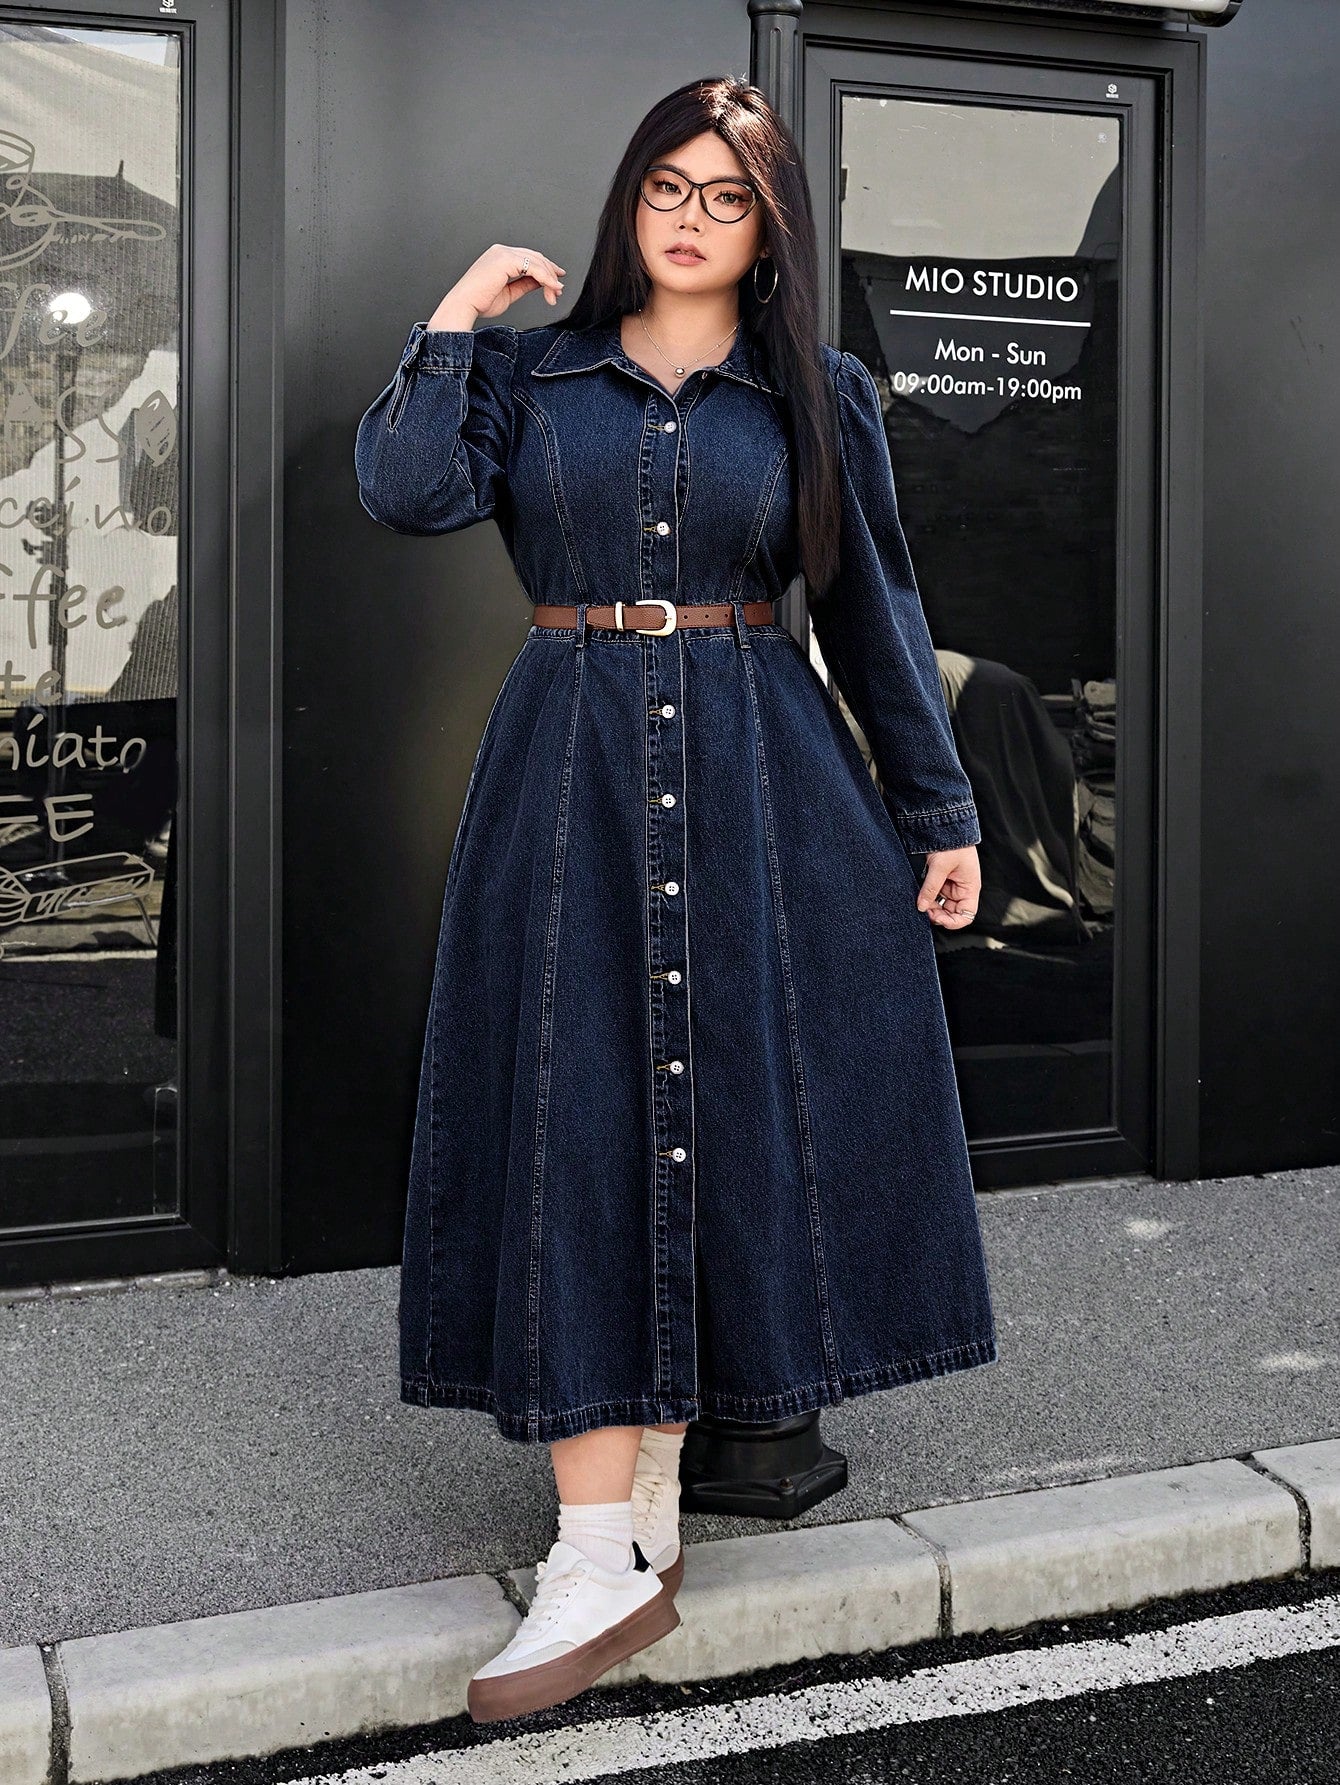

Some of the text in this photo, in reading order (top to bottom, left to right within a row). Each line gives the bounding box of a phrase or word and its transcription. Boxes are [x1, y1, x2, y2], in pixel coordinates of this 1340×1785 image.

[905, 265, 1079, 302] MIO STUDIO
[934, 338, 984, 362] Mon
[1006, 342, 1046, 366] Sun
[893, 371, 1082, 404] 09:00am-19:00pm
[0, 563, 128, 650] fee
